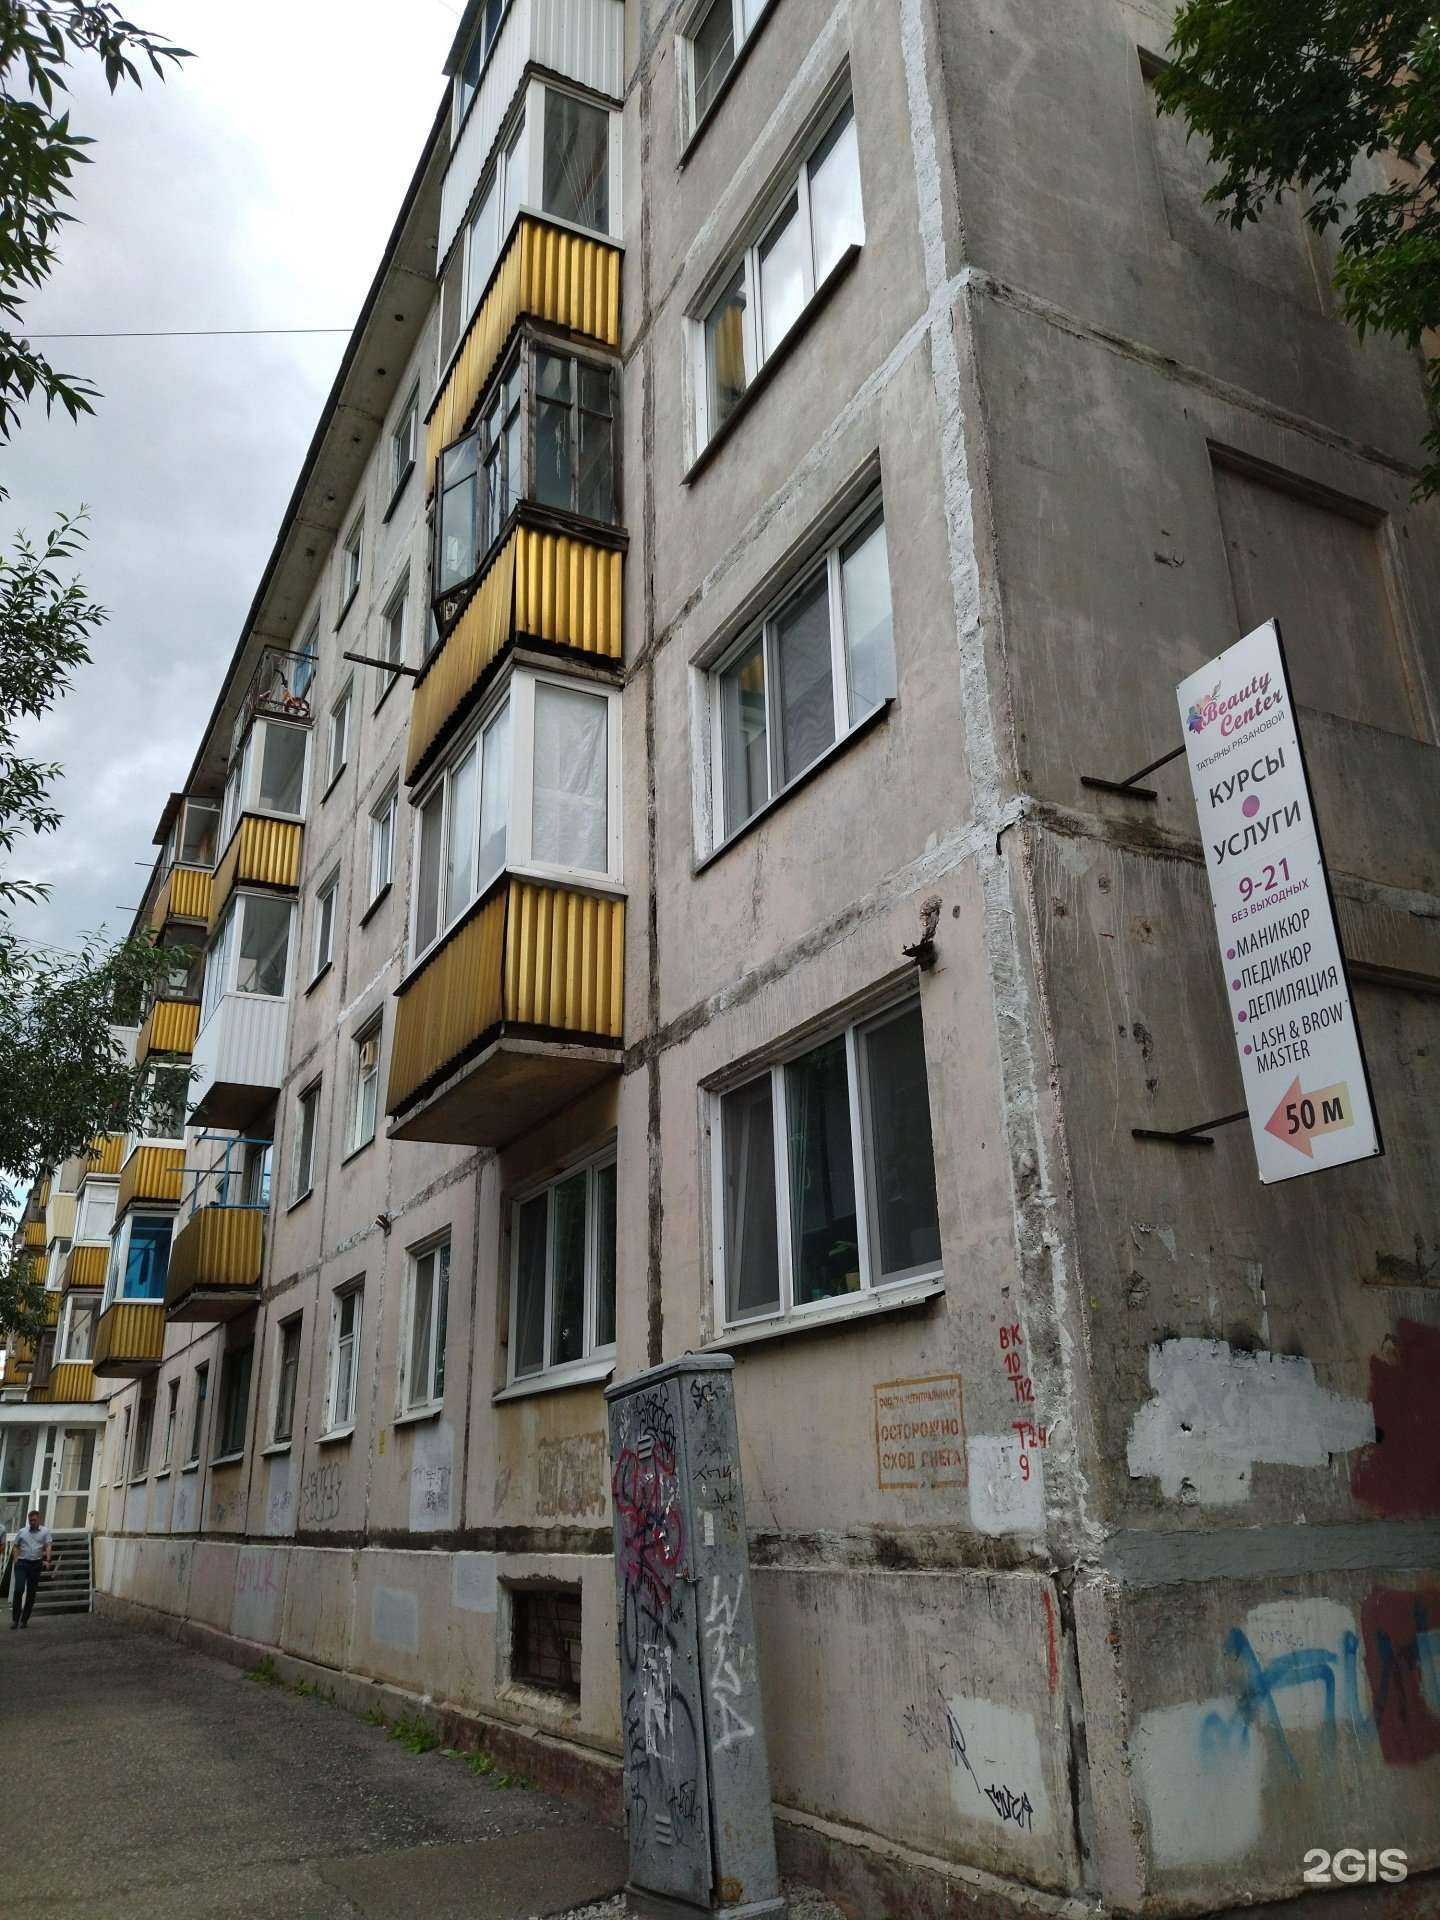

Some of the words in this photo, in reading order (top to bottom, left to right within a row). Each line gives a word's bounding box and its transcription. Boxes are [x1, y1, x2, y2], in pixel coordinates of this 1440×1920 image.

[1203, 672, 1271, 725] Beauty
[1221, 689, 1282, 736] Center
[1196, 745, 1231, 771] ТАТЬЯНЫ
[1232, 711, 1285, 749] РЯЗАНОВОЙ
[1209, 747, 1285, 808] КУРСЫ
[1213, 800, 1301, 865] УСЛУГИ
[1231, 907, 1249, 923] БЕЗ
[1250, 879, 1309, 915] ВЫХОДНЫХ
[1238, 858, 1290, 901] 9-21
[1236, 908, 1310, 958] МАНИКЮР
[1241, 942, 1312, 989] ПЕДИКЮР
[1248, 966, 1339, 1023] ДЕПИЛЯЦИЯ
[1253, 1022, 1286, 1053] LASH
[1289, 1020, 1299, 1038] &
[1302, 1002, 1343, 1034] BROW
[1257, 1039, 1310, 1074] MASTER
[1286, 1102, 1315, 1135] 50
[881, 1419, 959, 1441] ОСТОРОЖНО
